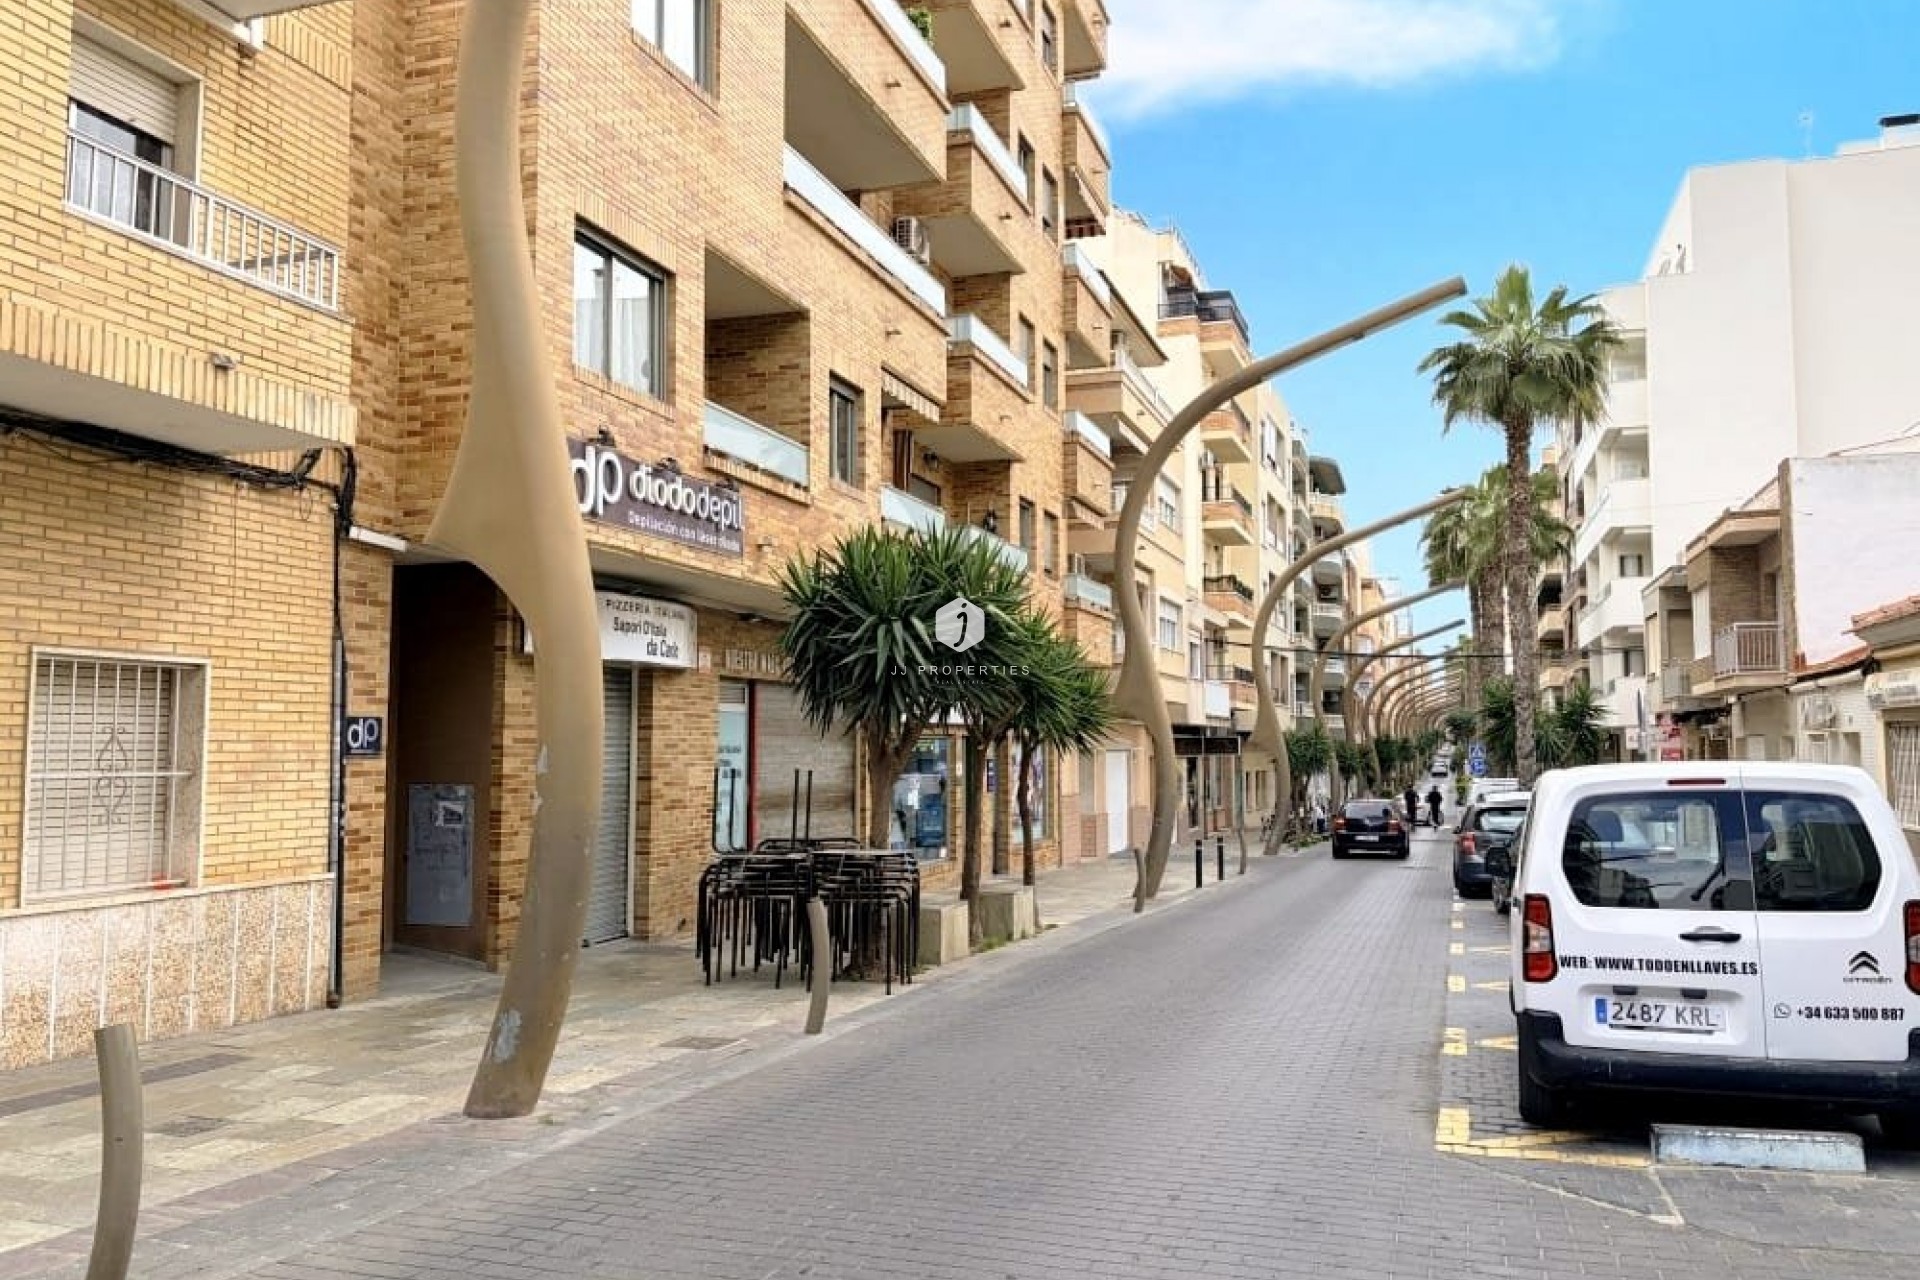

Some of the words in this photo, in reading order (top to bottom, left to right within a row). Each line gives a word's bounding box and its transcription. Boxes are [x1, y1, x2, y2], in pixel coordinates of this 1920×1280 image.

[571, 445, 623, 516] dp
[629, 464, 743, 531] diododepil
[606, 599, 650, 614] PIZZERIA
[613, 616, 642, 636] Sapori
[646, 636, 657, 656] da
[347, 717, 379, 749] dp
[1559, 955, 1592, 970] WEB:
[1593, 956, 1758, 975] WWW.TODOENLLAVES.ES
[1612, 1001, 1666, 1023] 2487
[1675, 1006, 1719, 1027] KRL
[1796, 1006, 1821, 1020] +34
[1823, 1006, 1850, 1021] 633
[1852, 1007, 1878, 1021] 500
